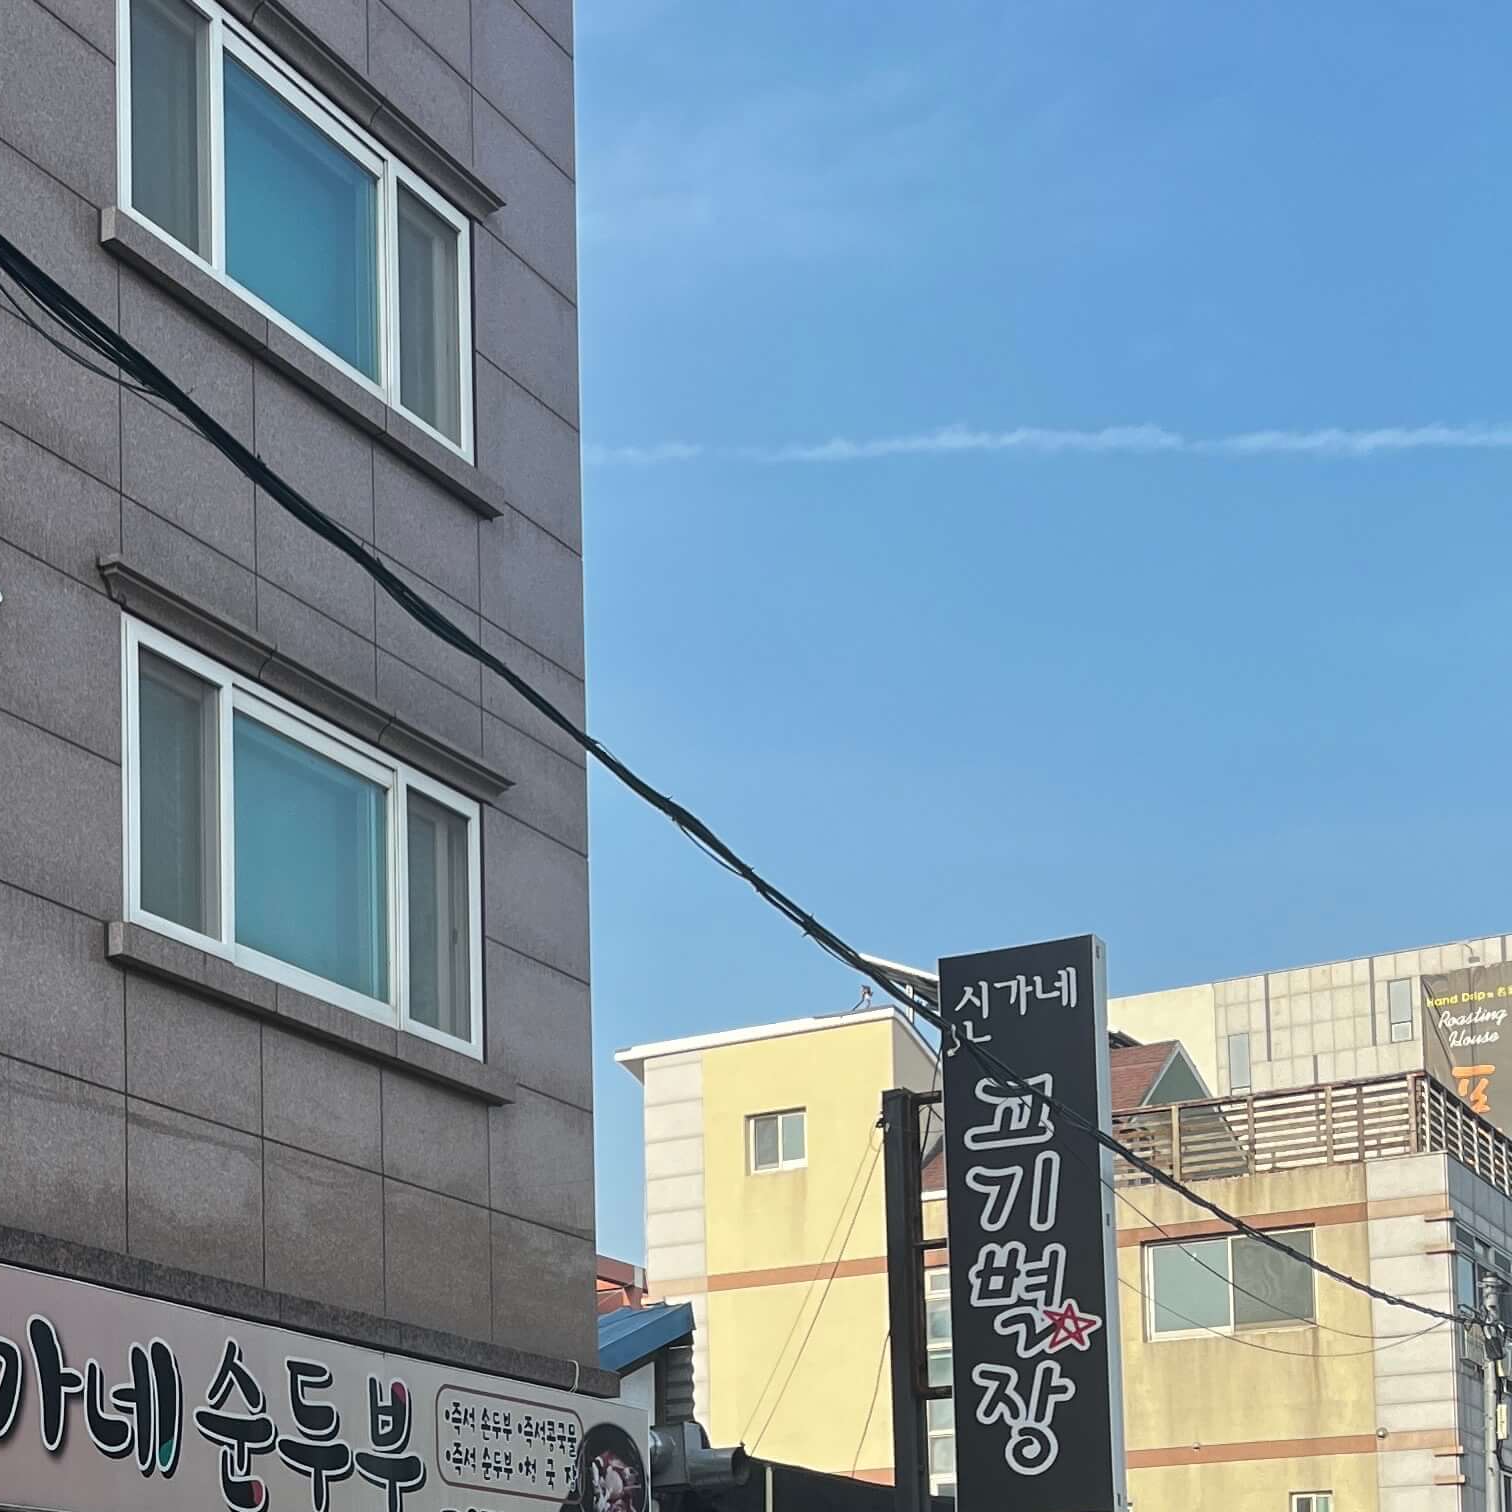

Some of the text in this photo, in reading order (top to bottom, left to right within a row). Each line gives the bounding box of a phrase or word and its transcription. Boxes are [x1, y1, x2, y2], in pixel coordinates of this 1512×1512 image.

[954, 966, 1078, 1042] 신가네
[1426, 995, 1458, 1008] Hand
[1438, 1006, 1508, 1029] Roasting
[1449, 1030, 1500, 1048] House
[964, 1072, 1090, 1476] 고기별장
